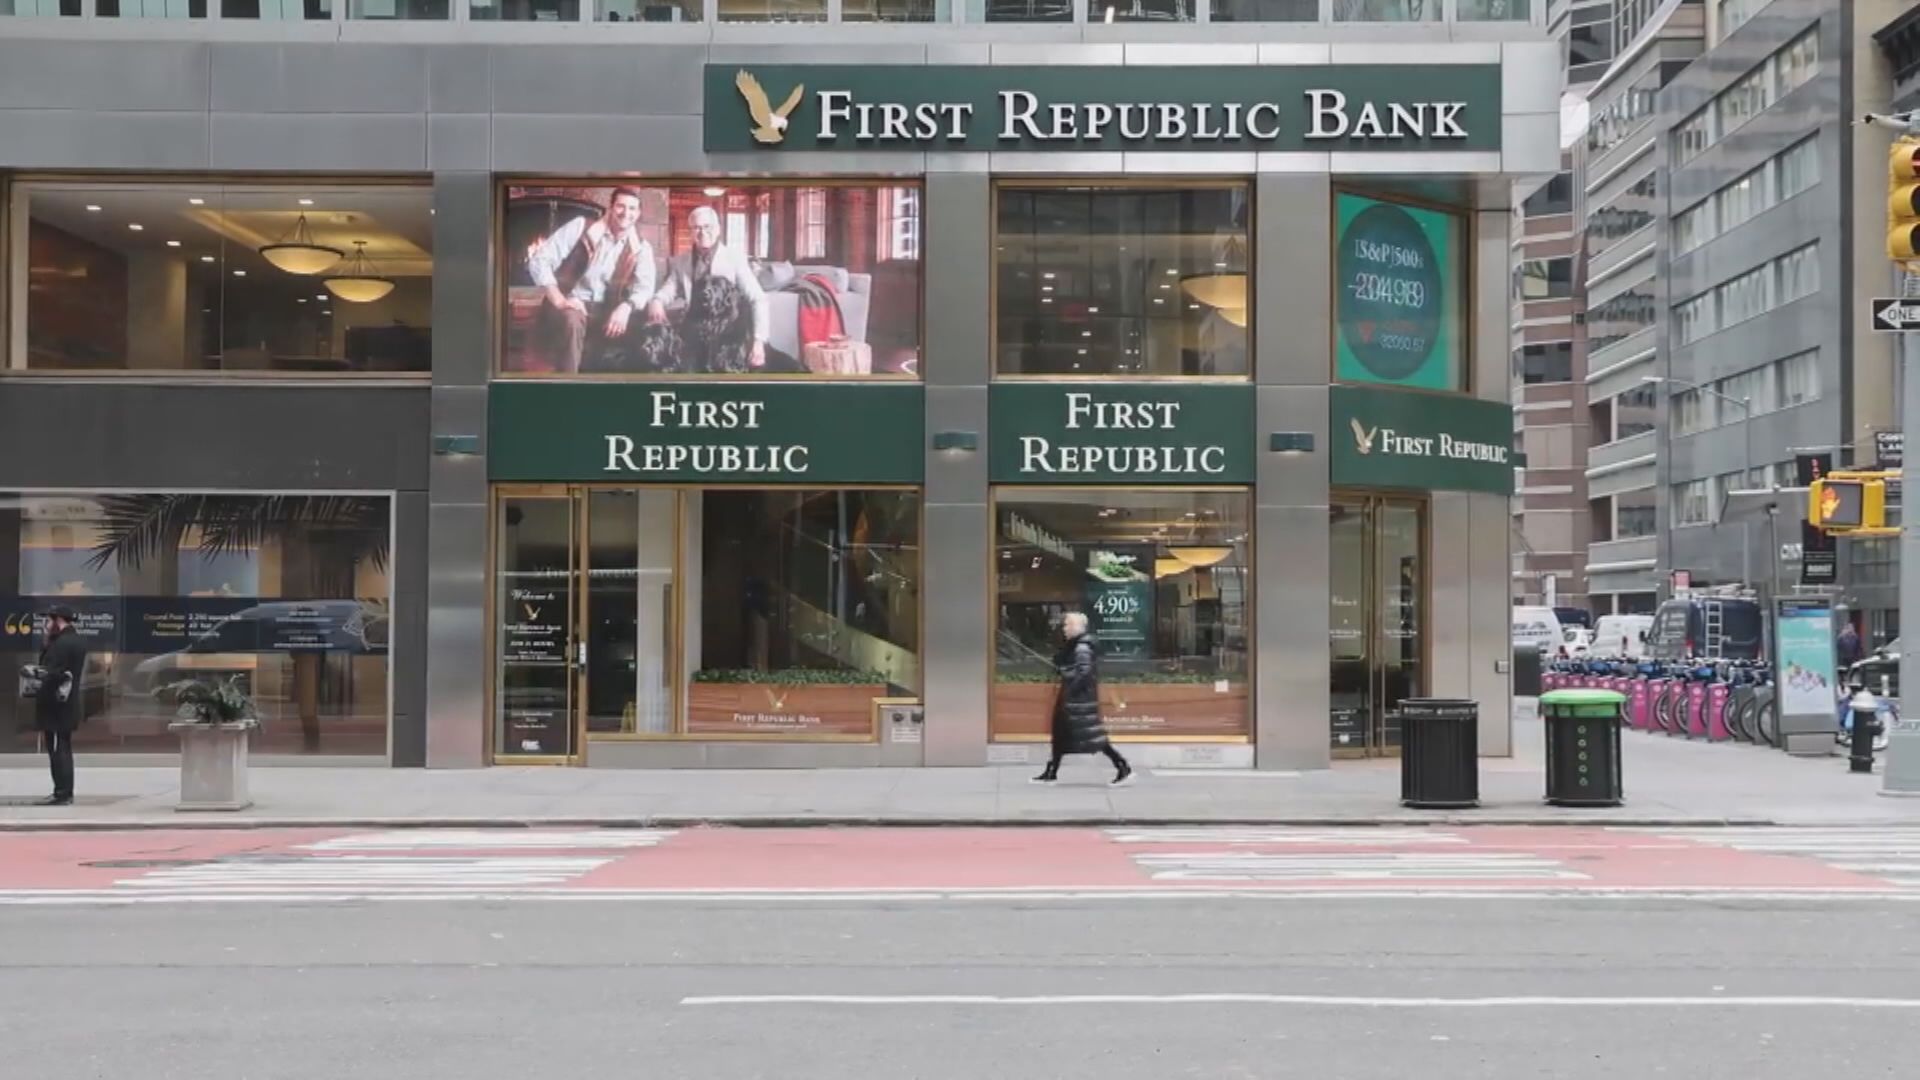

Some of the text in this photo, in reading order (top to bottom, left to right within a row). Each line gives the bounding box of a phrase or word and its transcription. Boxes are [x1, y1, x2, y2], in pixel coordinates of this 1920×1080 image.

[816, 88, 1469, 140] FIRST REPUBLIC BANK
[1888, 308, 1917, 320] ONE
[649, 391, 765, 428] FIRST
[1065, 392, 1180, 429] FIRST
[603, 434, 810, 473] REPUBLIC
[1019, 436, 1226, 474] REPUBLIC
[1380, 428, 1508, 464] FIRST REPUBLIC
